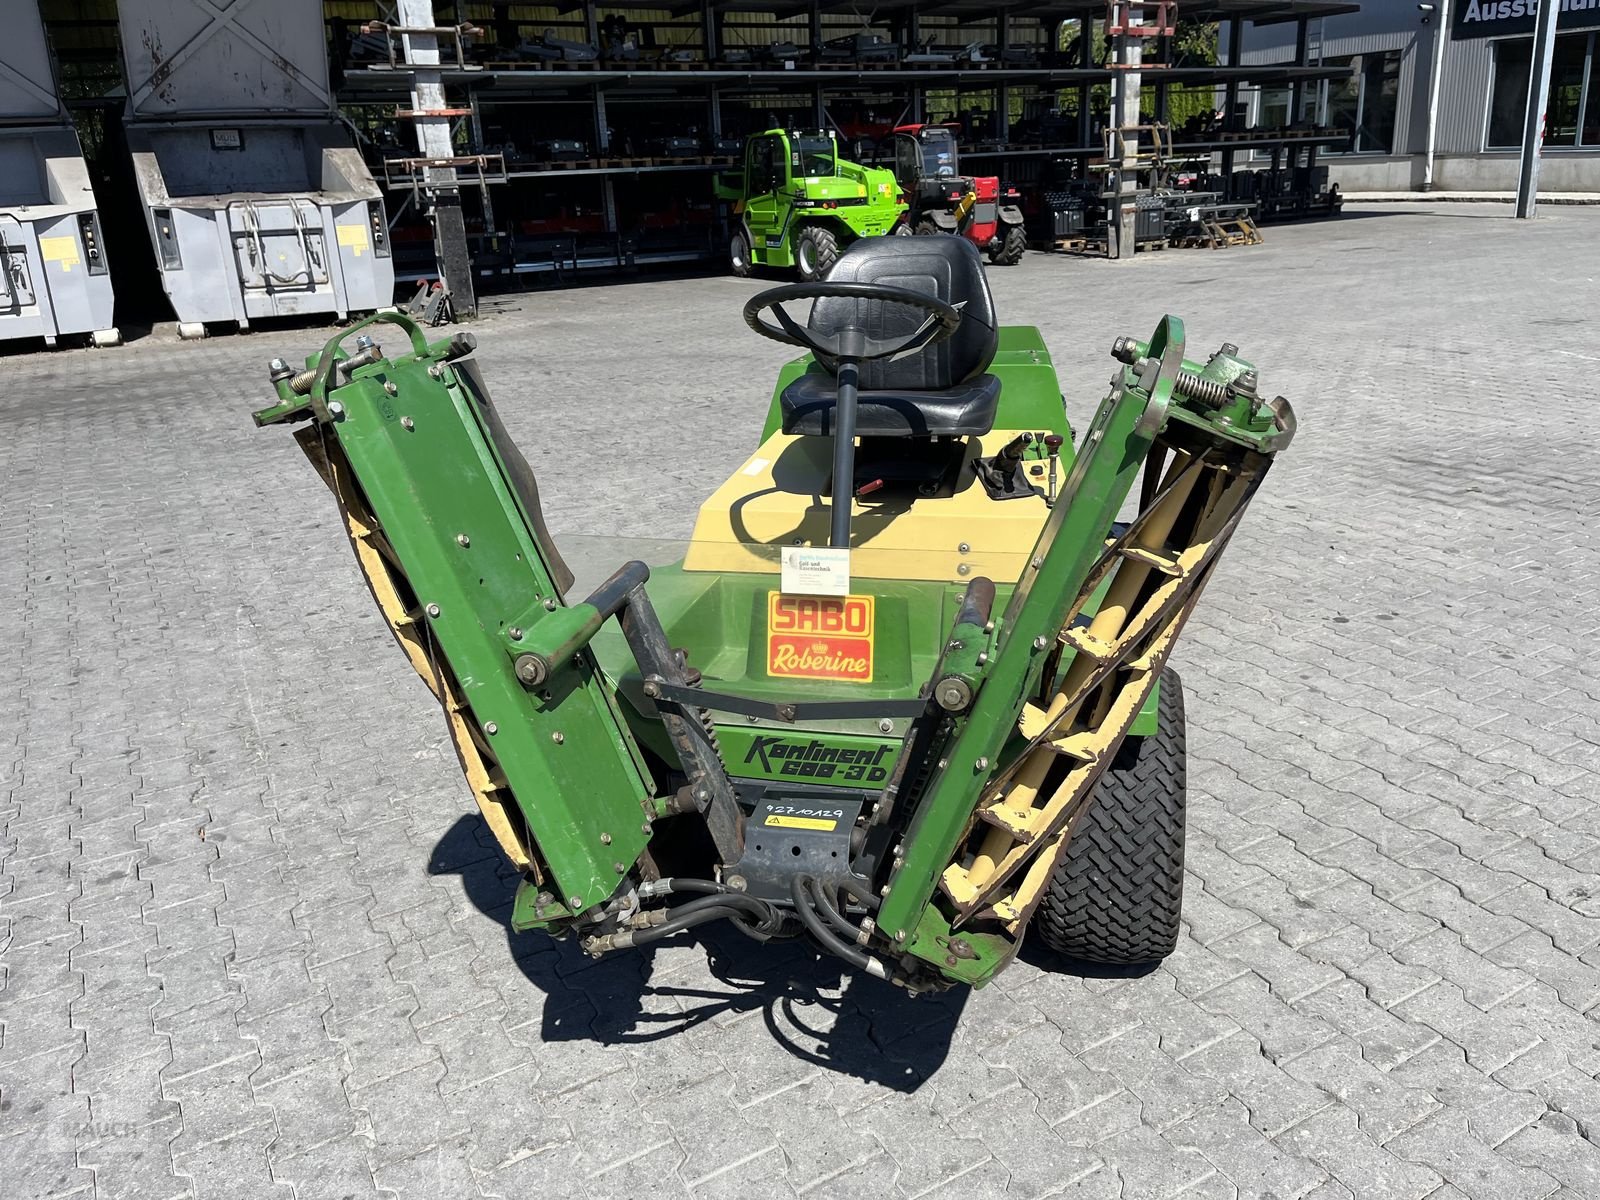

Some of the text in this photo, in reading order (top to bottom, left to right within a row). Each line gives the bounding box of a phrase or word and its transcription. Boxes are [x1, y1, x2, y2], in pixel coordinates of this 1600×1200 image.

[775, 599, 866, 632] SABO
[774, 644, 867, 672] Roberine
[744, 736, 893, 773] Kontinent
